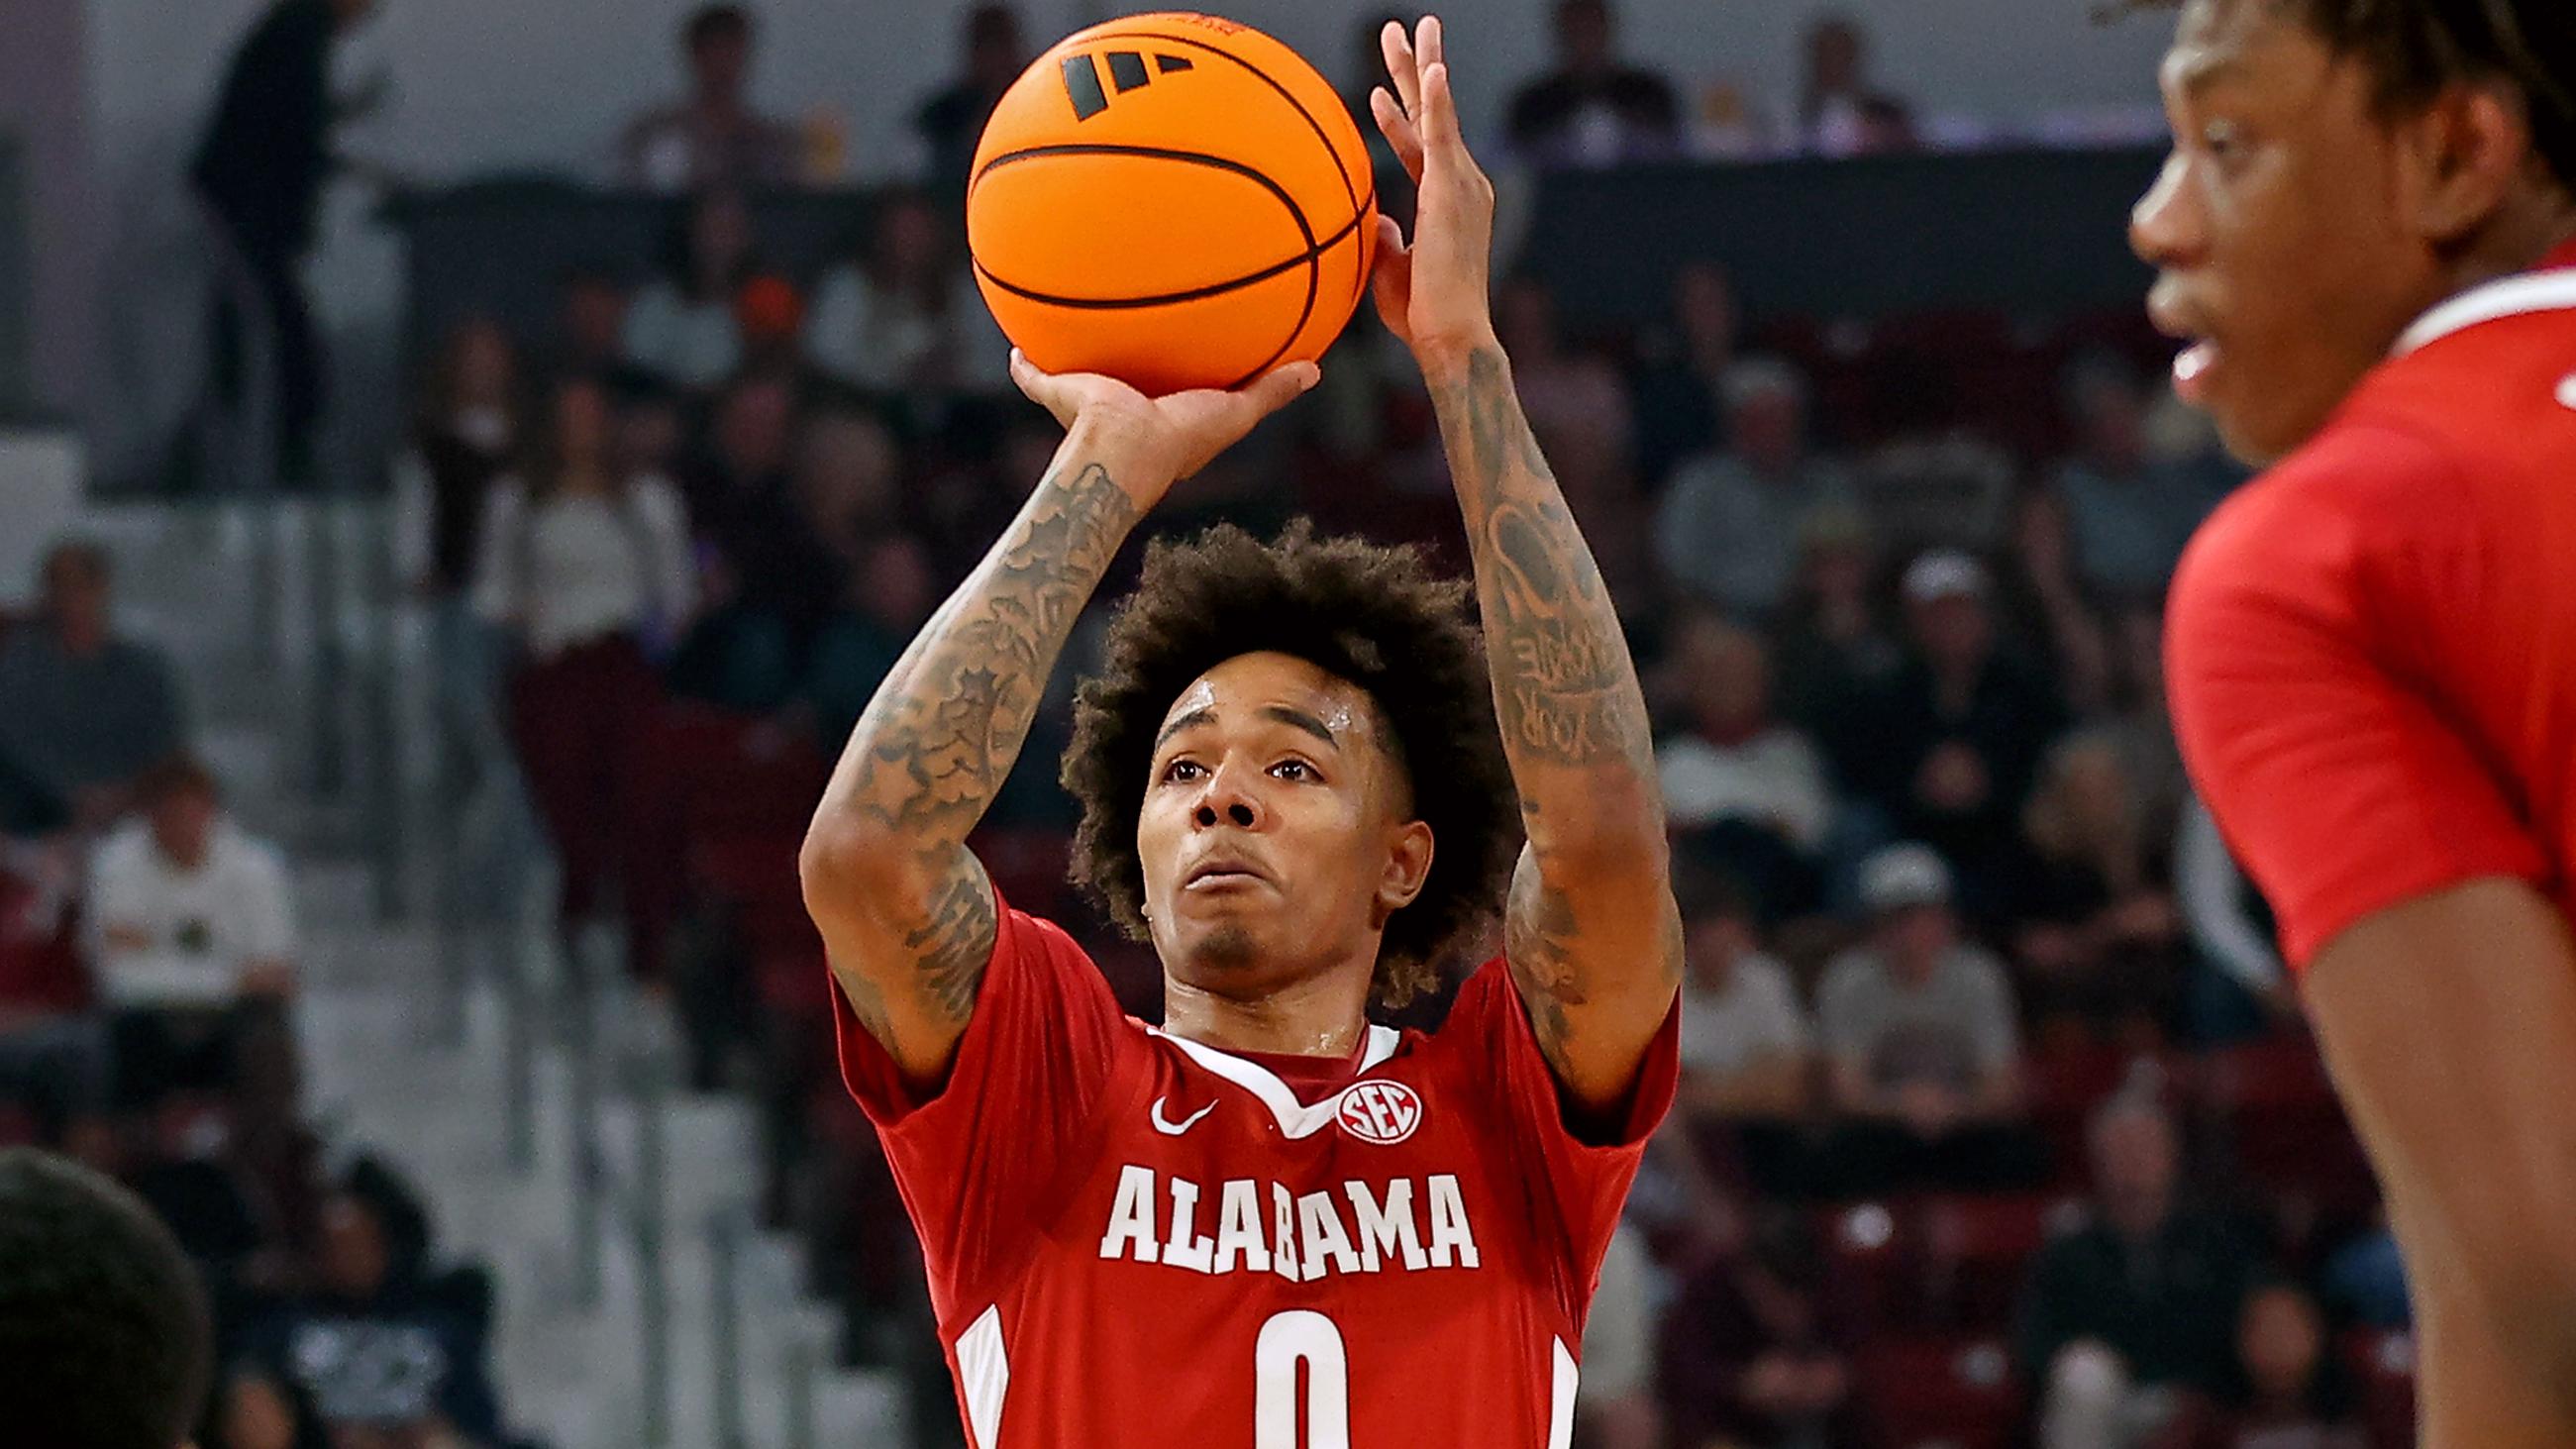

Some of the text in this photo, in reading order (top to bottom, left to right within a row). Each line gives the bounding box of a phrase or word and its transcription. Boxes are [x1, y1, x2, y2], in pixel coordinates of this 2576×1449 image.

[1342, 1085, 1414, 1138] SEC
[1099, 1164, 1480, 1283] ALABAMA
[1255, 1309, 1350, 1449] 0
